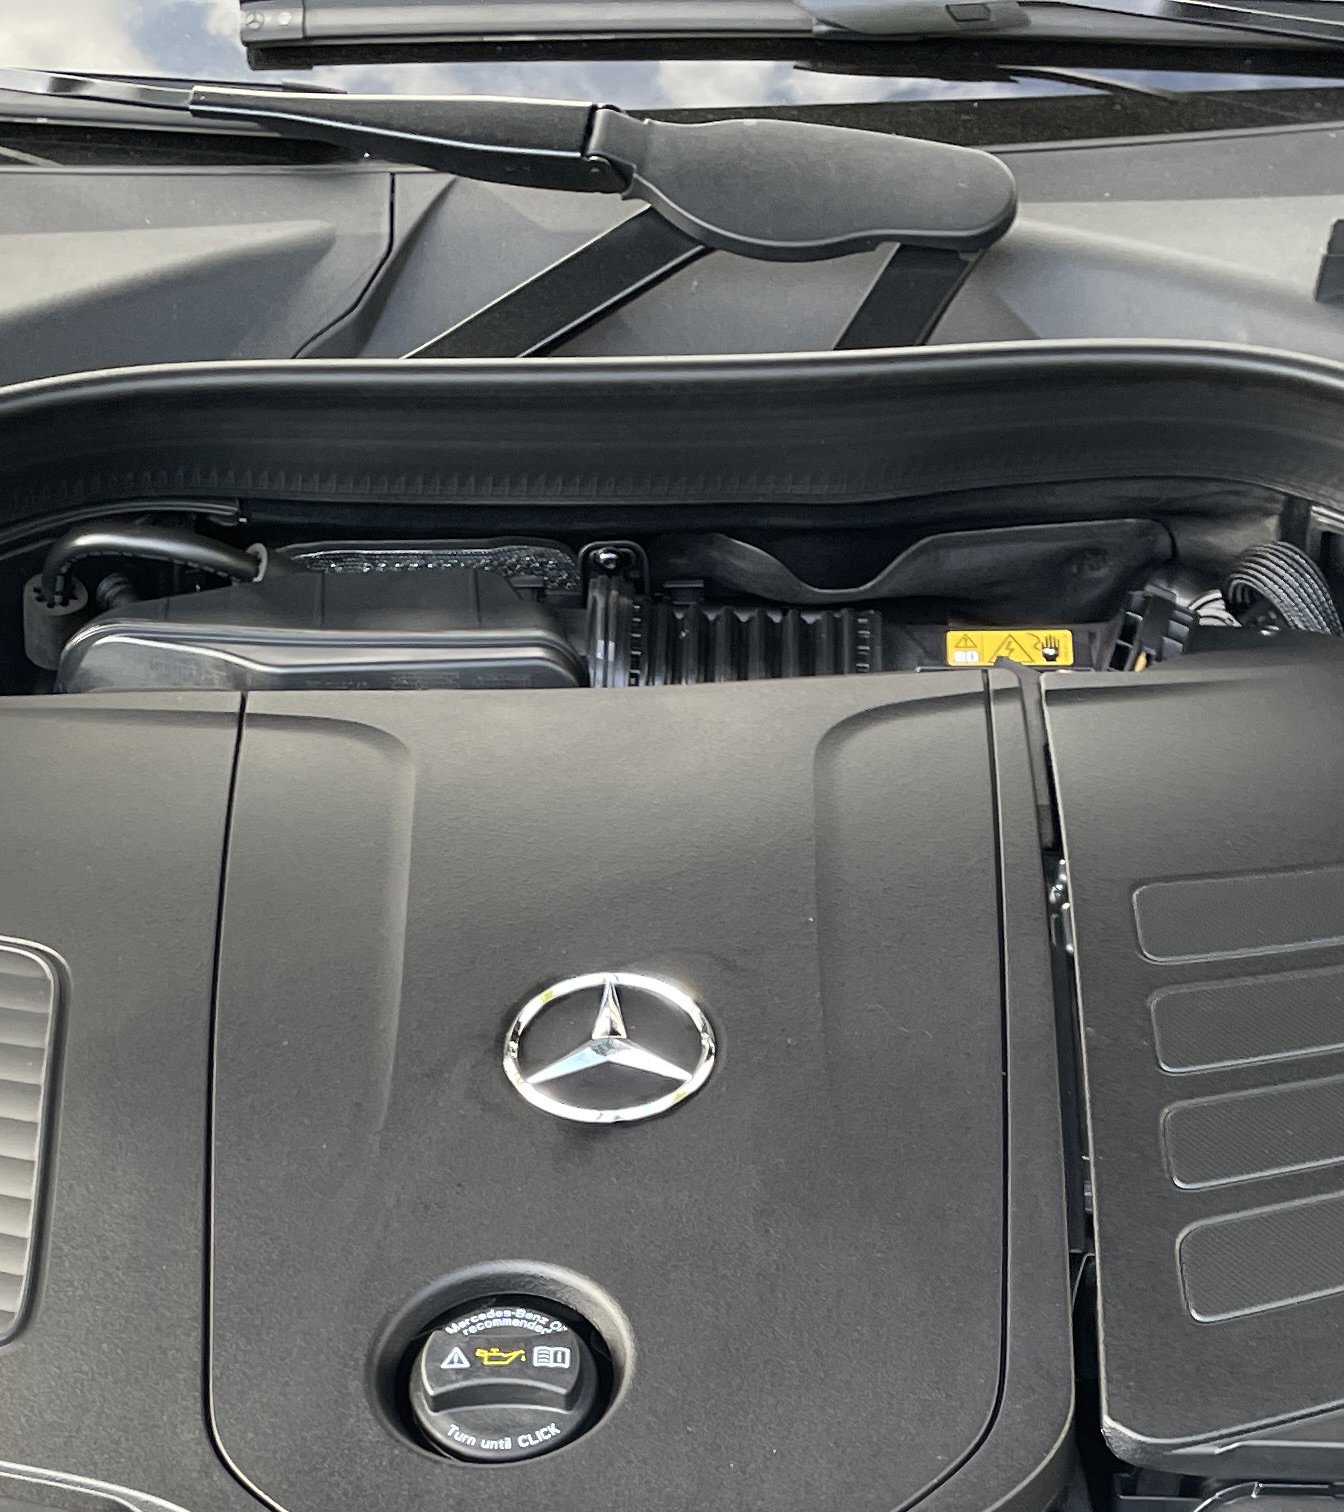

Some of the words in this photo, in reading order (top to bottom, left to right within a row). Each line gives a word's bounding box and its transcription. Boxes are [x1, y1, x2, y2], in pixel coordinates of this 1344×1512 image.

[445, 1308, 550, 1334] Mercedes-Benz
[447, 1424, 477, 1446] Turn
[480, 1437, 512, 1450] until
[517, 1422, 561, 1448] CLICK
